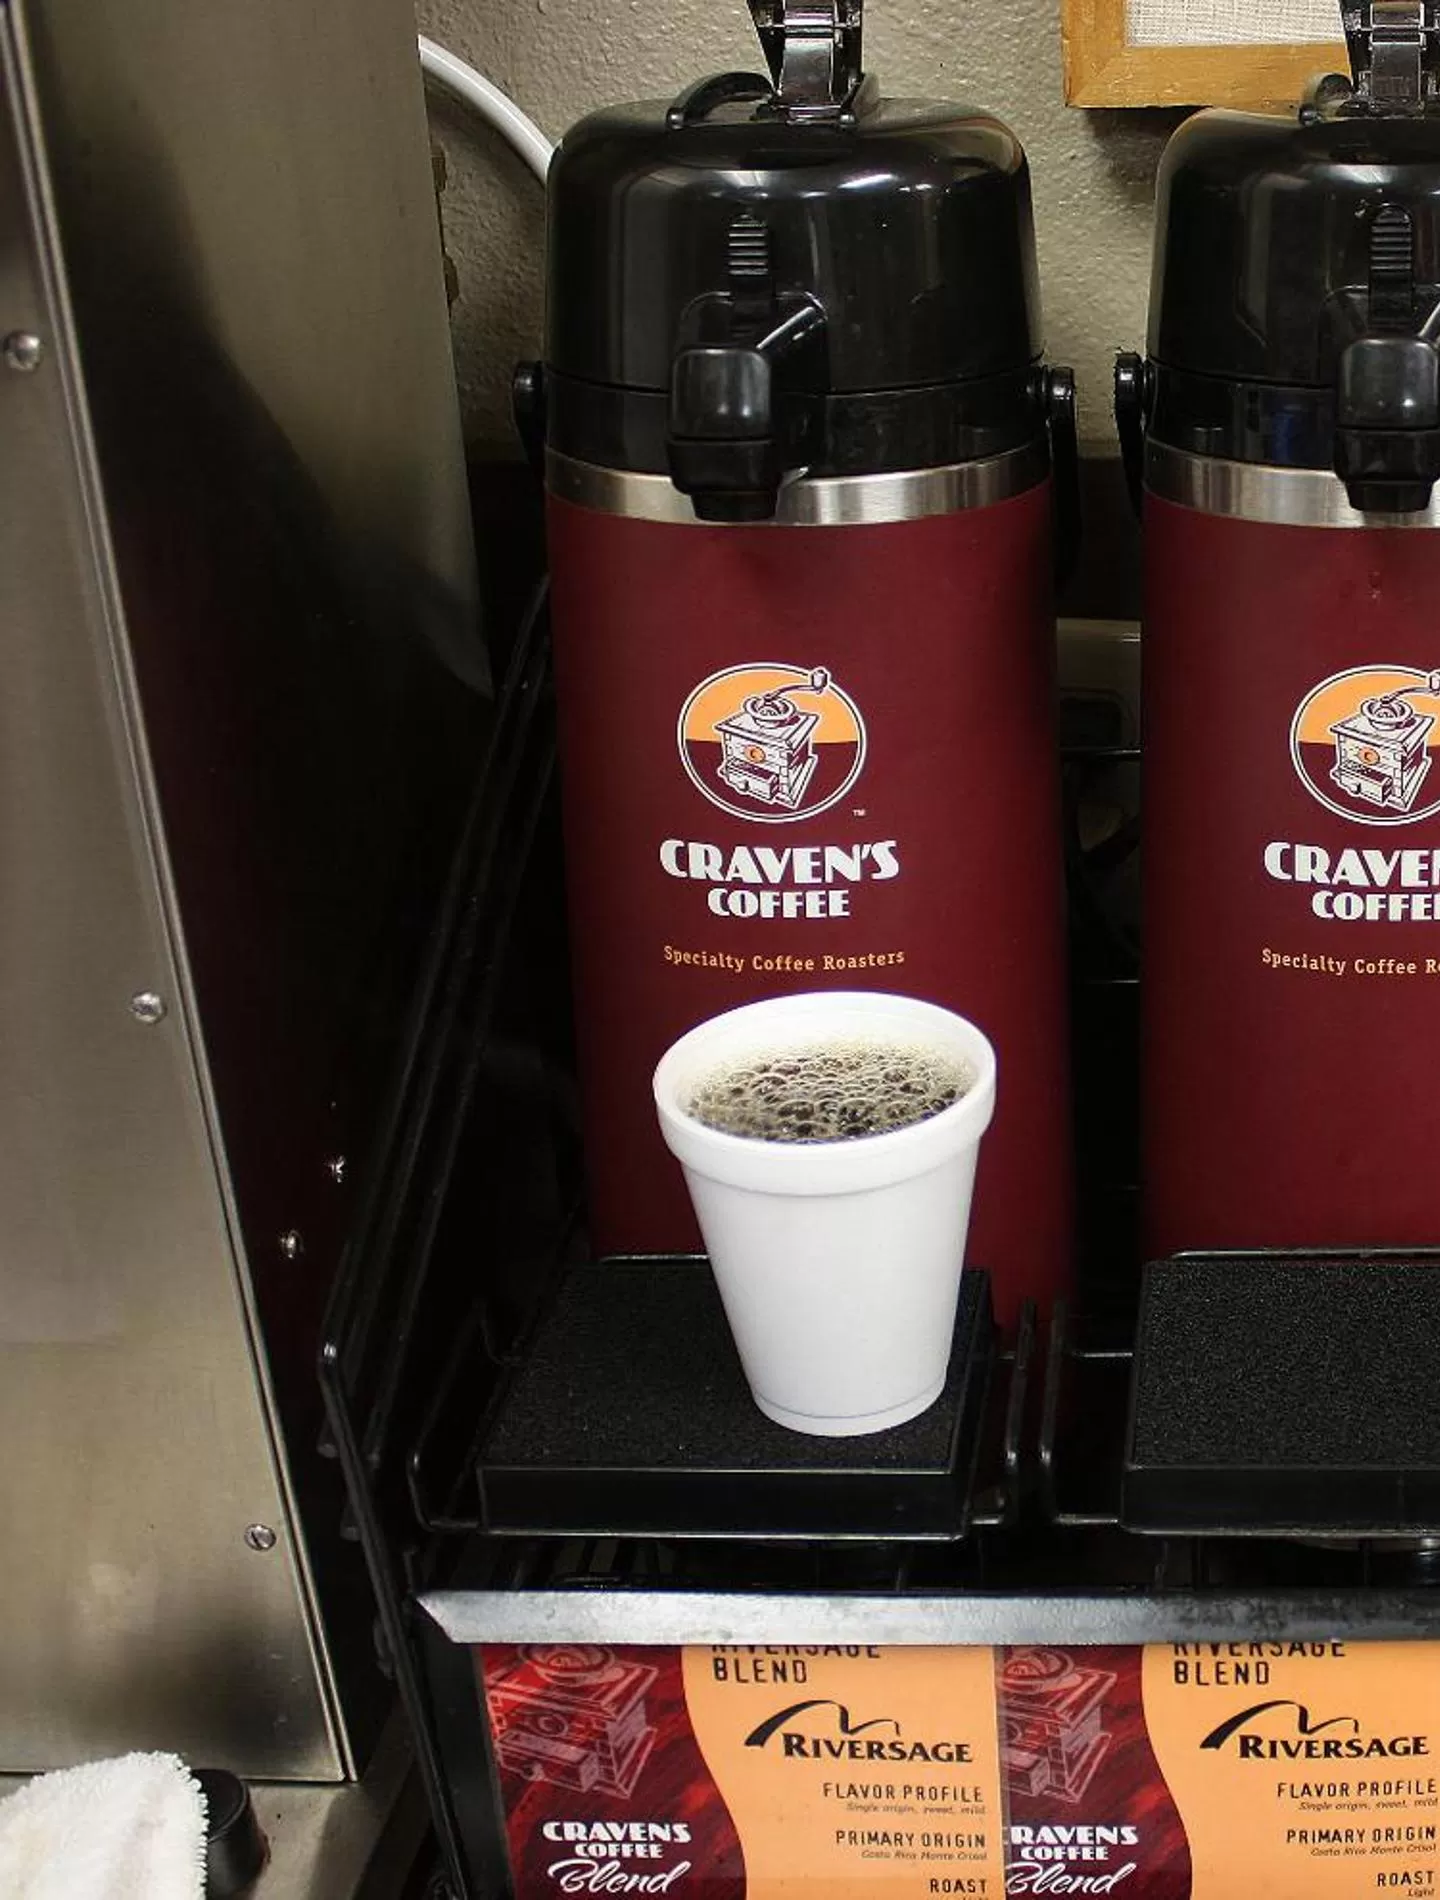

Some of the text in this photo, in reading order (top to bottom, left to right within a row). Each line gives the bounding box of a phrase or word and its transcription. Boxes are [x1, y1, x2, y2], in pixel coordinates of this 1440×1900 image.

[659, 839, 900, 883] CRAVEN'S
[707, 888, 850, 918] COFFEE
[663, 945, 905, 973] Specialty Coffee Roasters
[1262, 948, 1347, 975] Specialty
[1354, 958, 1417, 974] Coffee
[712, 1656, 808, 1684] BLEND
[1174, 1660, 1270, 1685] BLEND
[782, 1732, 973, 1764] RIVERSAGE
[1239, 1734, 1430, 1760] RIVERSAGE
[822, 1782, 984, 1803] FLAVOR PROFILE
[1277, 1778, 1437, 1799] FLAVOR PROFILE
[541, 1821, 692, 1844] CRAVENS
[835, 1830, 986, 1849] PRIMARY ORIGIN
[1286, 1825, 1437, 1844] PRIMARY ORIGIN
[573, 1843, 664, 1860] COFFEE
[1020, 1845, 1110, 1861] COFFEE
[547, 1859, 693, 1895] Blend
[930, 1878, 988, 1894] ROAST
[1005, 1861, 1137, 1895] Blend
[1377, 1870, 1435, 1888] ROAST
